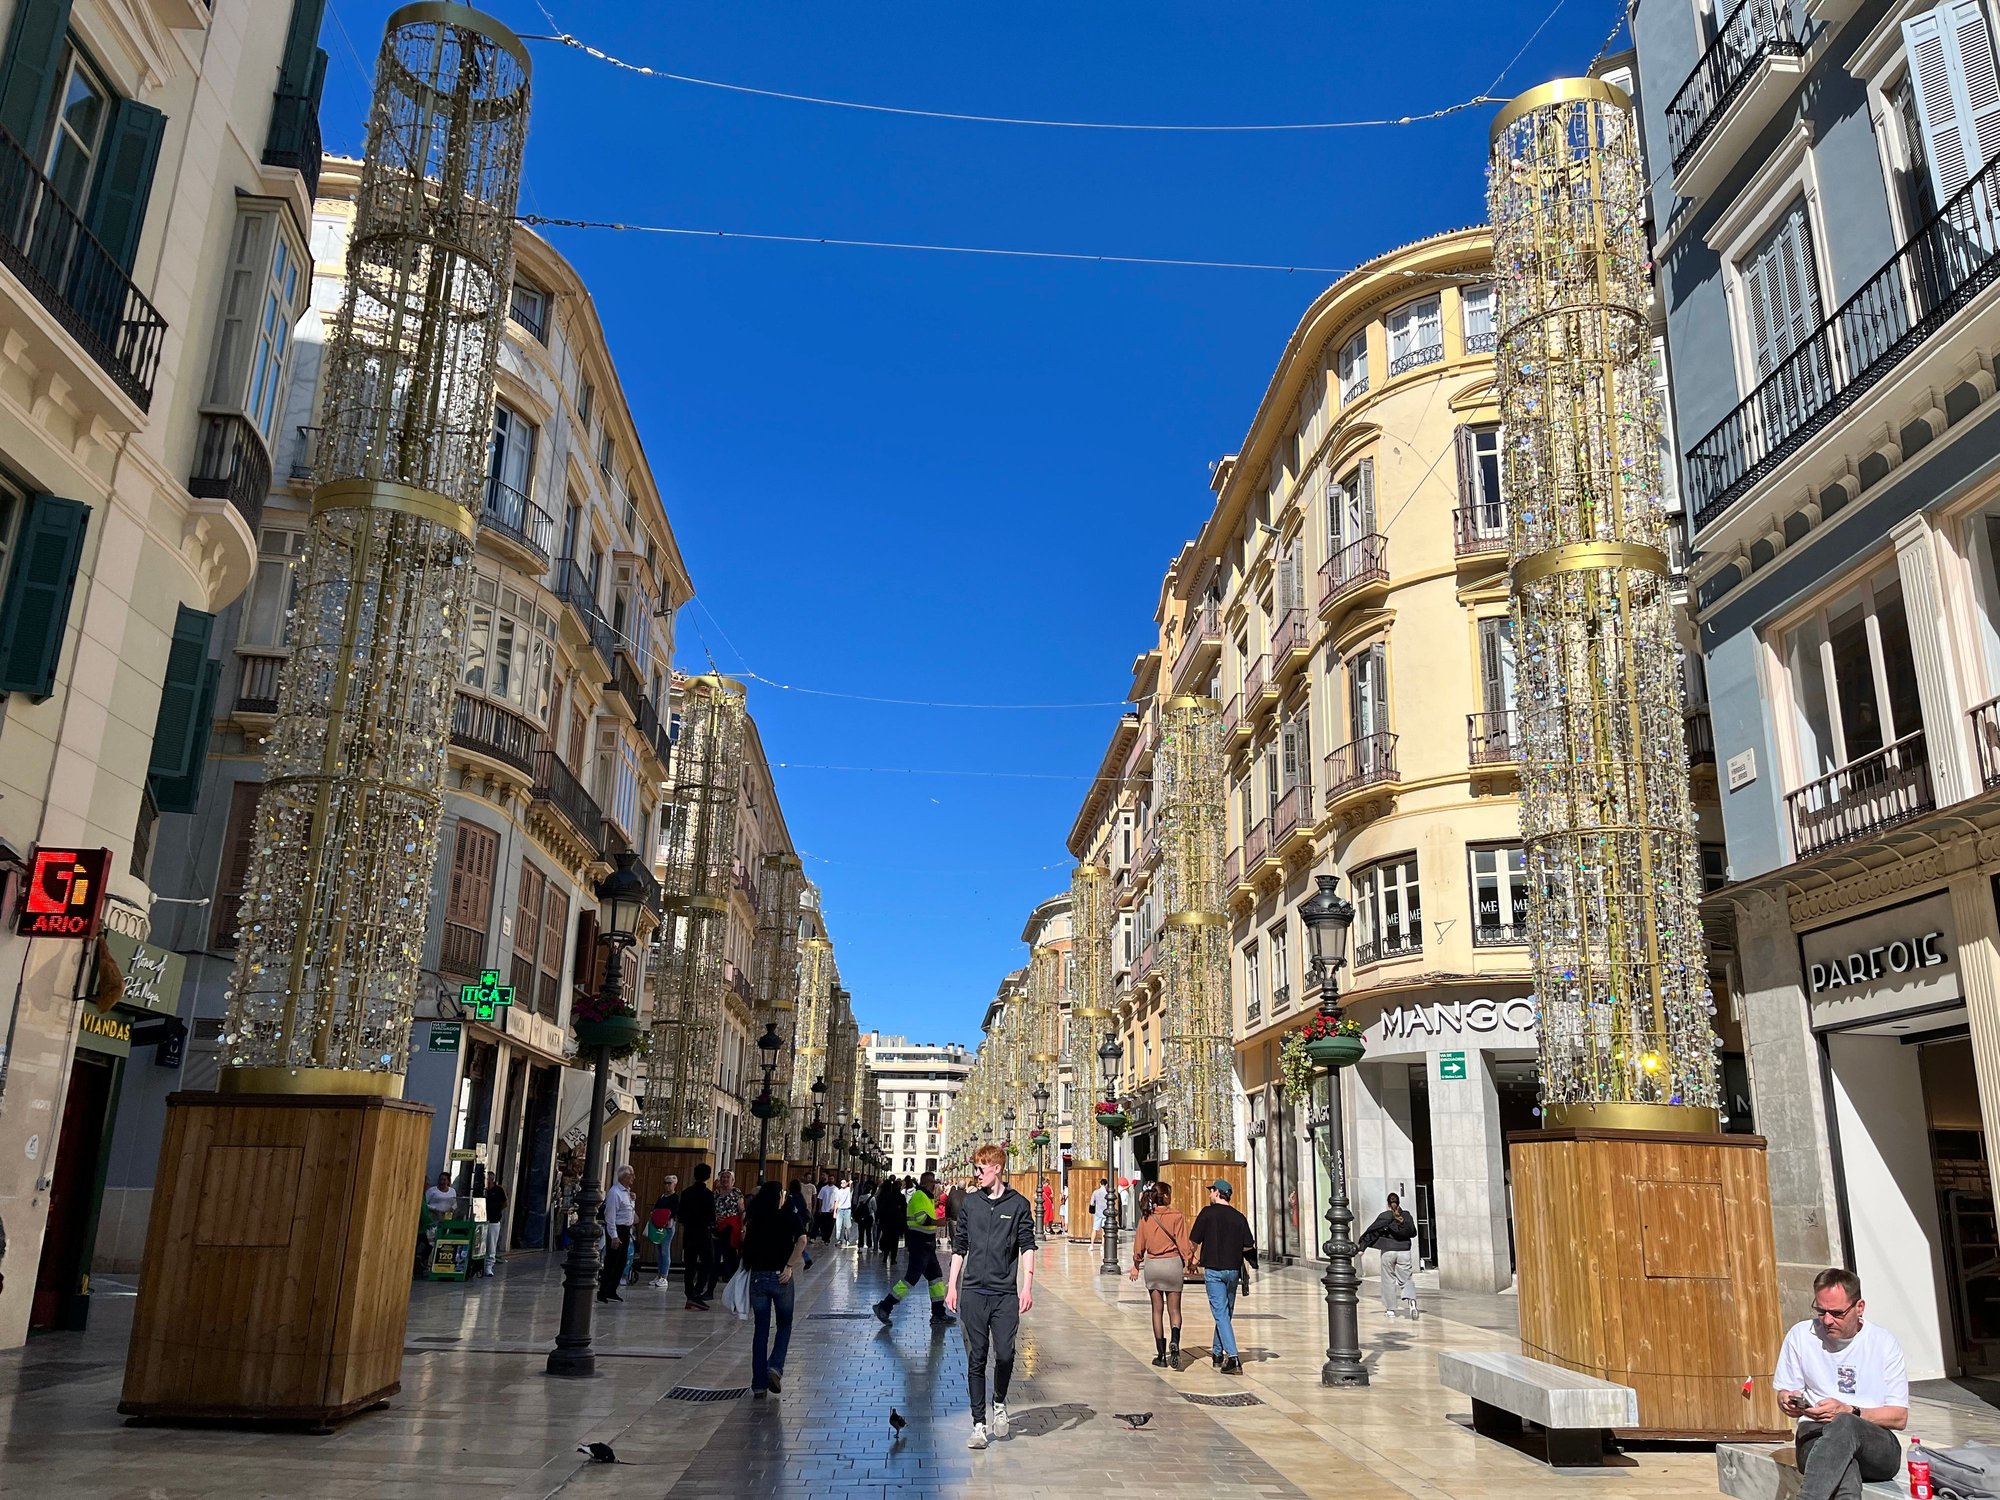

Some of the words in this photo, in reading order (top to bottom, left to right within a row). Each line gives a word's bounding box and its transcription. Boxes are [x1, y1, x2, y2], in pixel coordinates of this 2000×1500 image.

[23, 916, 89, 933] ARIO
[1811, 932, 1942, 993] PARFOIS
[465, 988, 500, 1001] TICA
[83, 1012, 131, 1041] VIANDAS
[1381, 998, 1536, 1040] MANGO
[439, 1252, 453, 1260] 120
